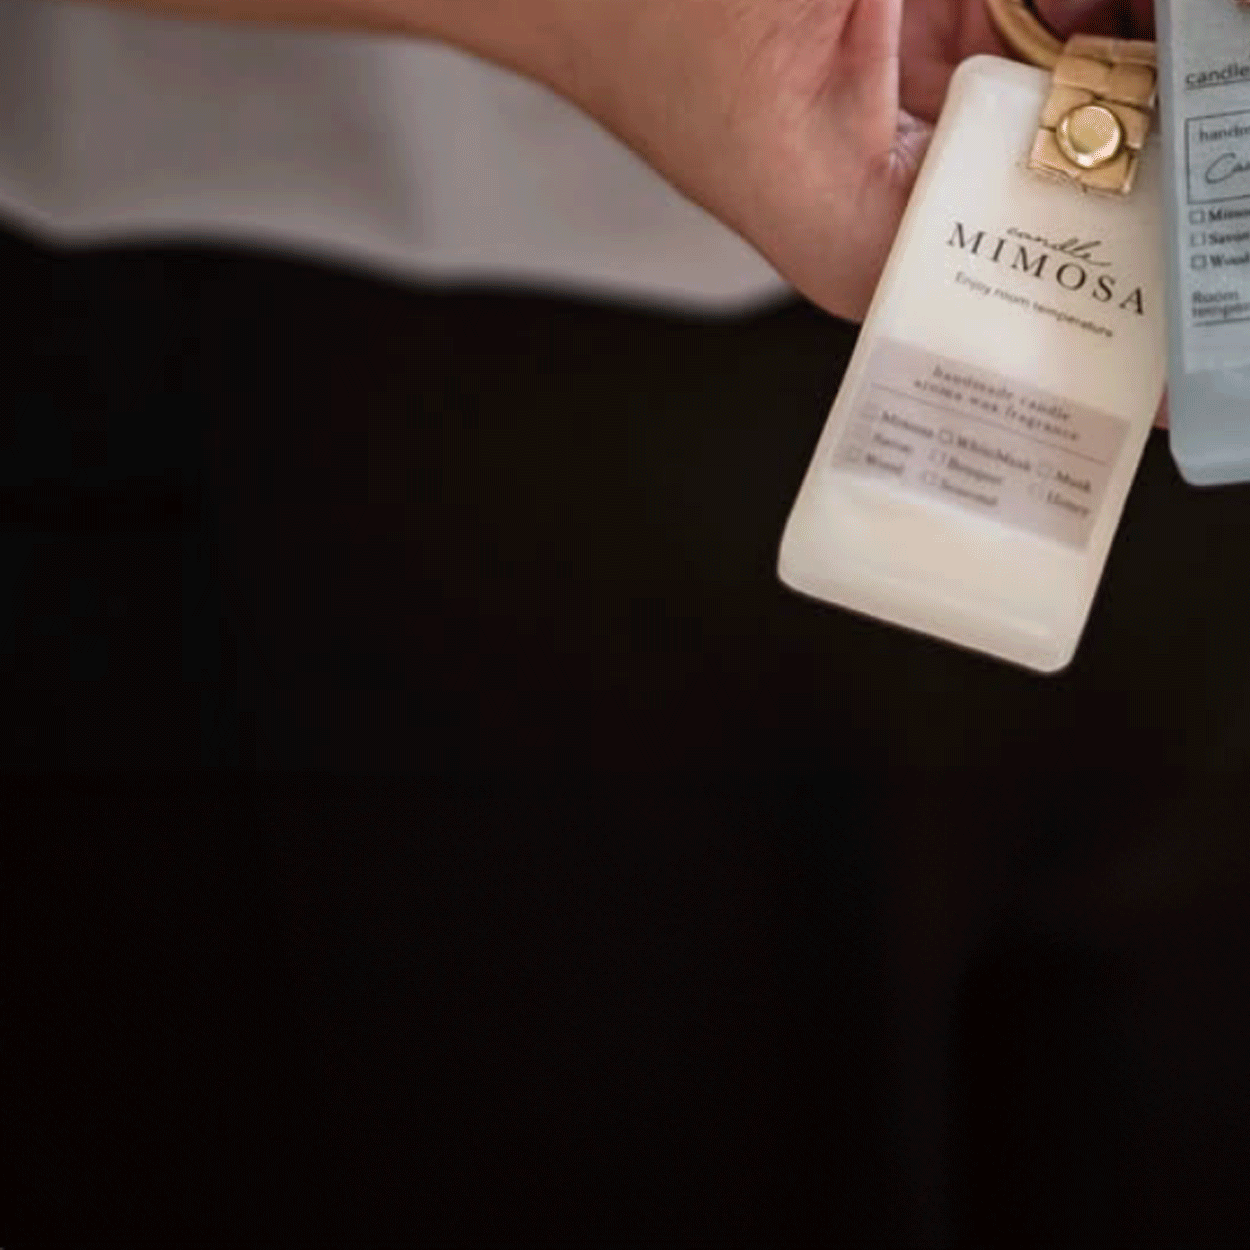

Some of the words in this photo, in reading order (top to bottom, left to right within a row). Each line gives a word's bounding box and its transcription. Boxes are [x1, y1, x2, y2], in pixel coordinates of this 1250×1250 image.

[1186, 63, 1250, 85] candle
[946, 221, 1145, 316] MIMOSA
[955, 271, 992, 296] Enjoy
[993, 288, 1030, 308] room
[1032, 302, 1114, 338] temperature
[1192, 291, 1240, 305] Room
